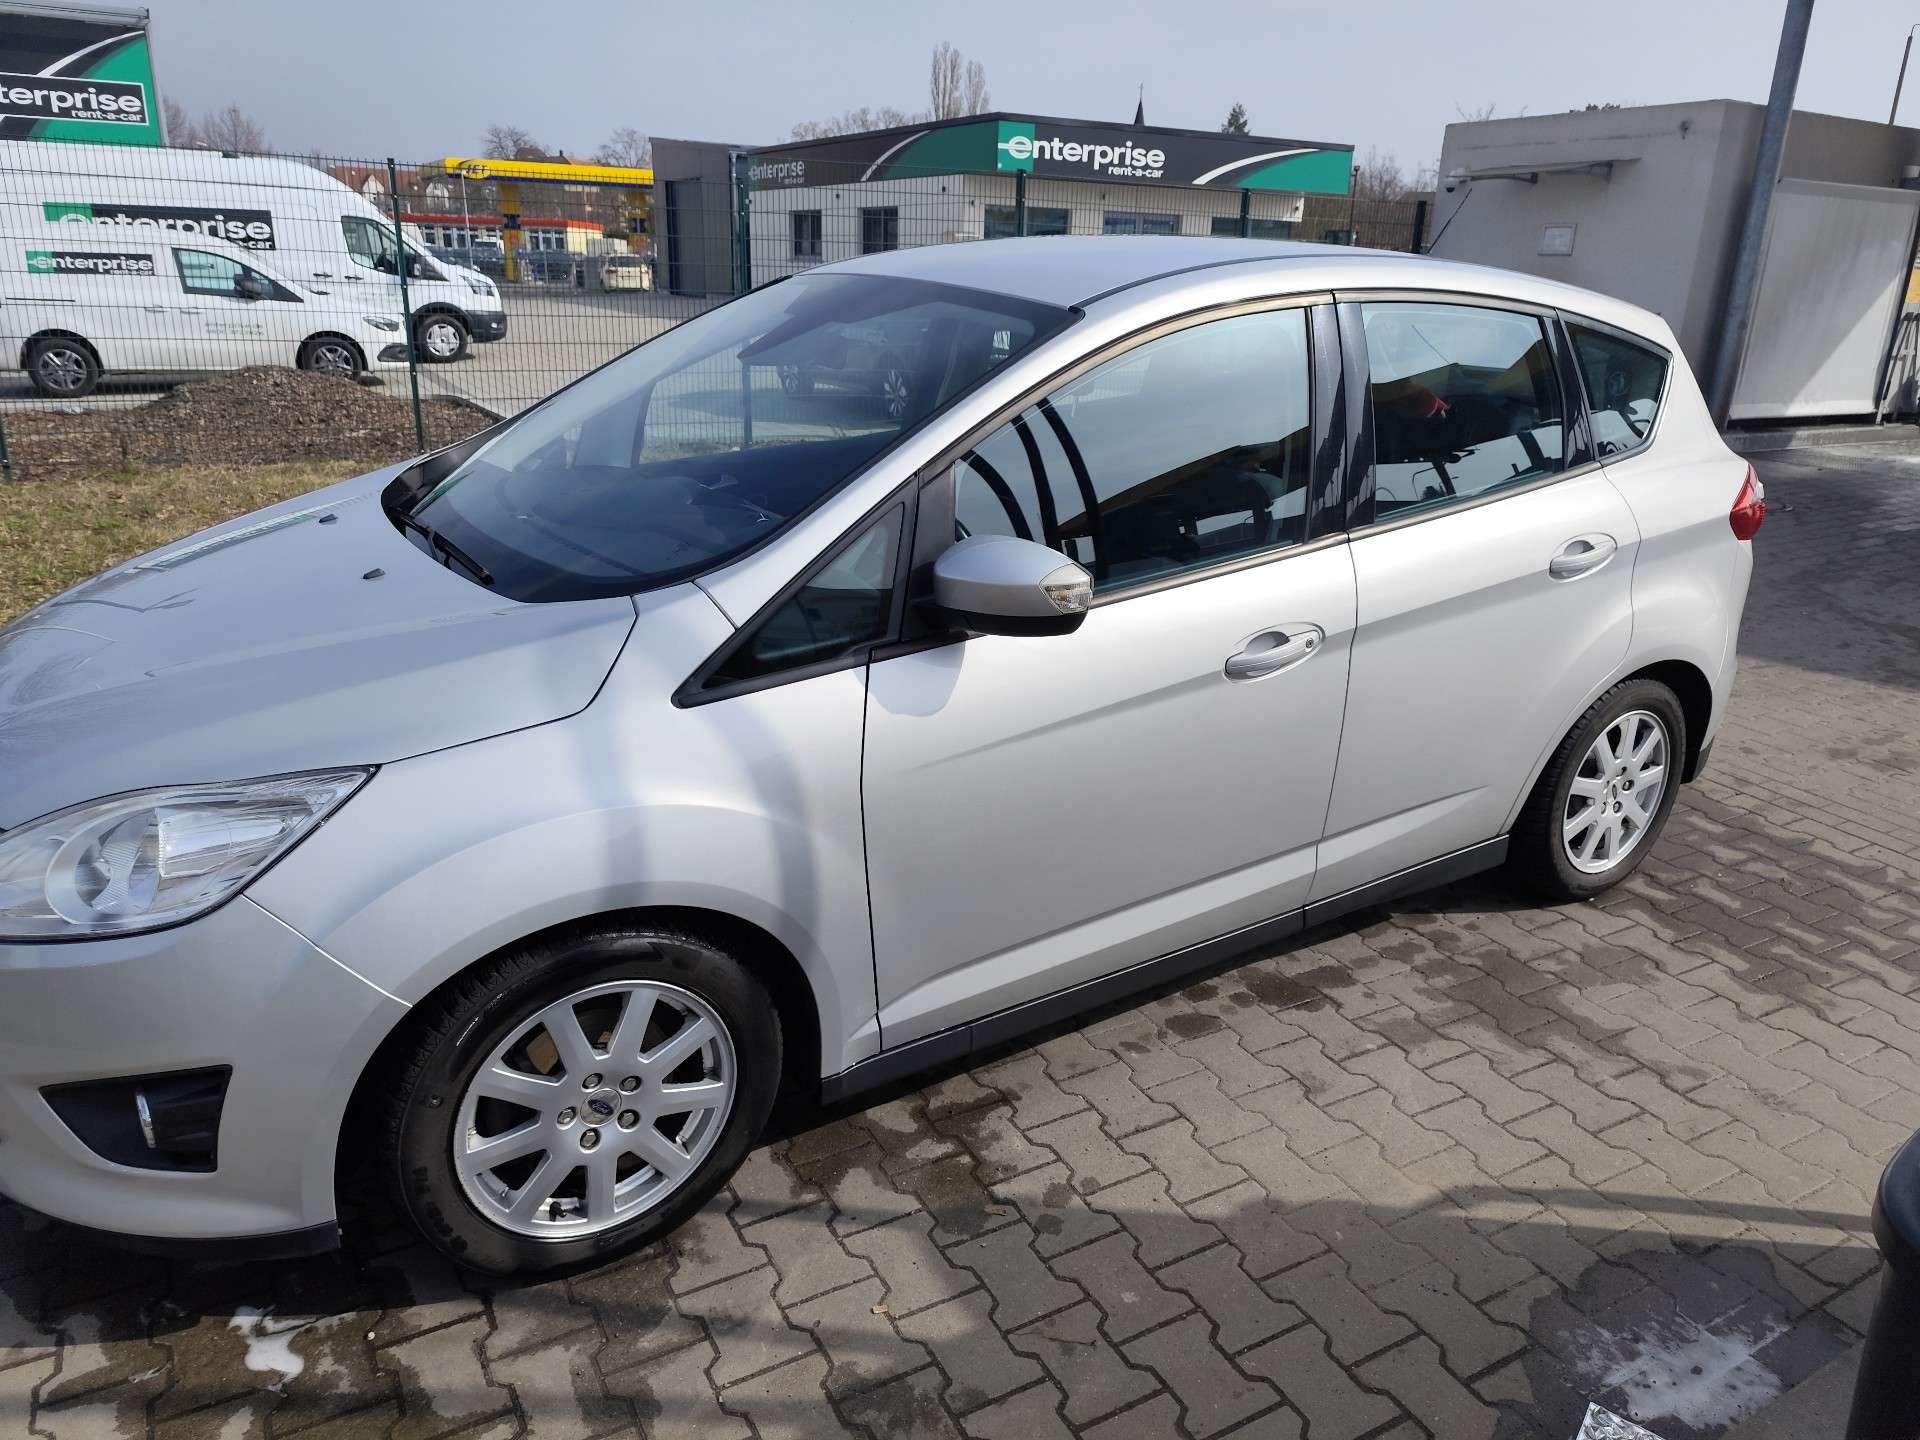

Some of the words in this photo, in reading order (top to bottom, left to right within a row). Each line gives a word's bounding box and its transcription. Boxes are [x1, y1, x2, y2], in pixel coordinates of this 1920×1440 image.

[71, 109, 143, 121] rent-a-car
[999, 135, 1166, 170] enterprise
[749, 160, 804, 182] enterprse
[1108, 166, 1164, 178] rent-a-car
[29, 256, 153, 272] enterprise
